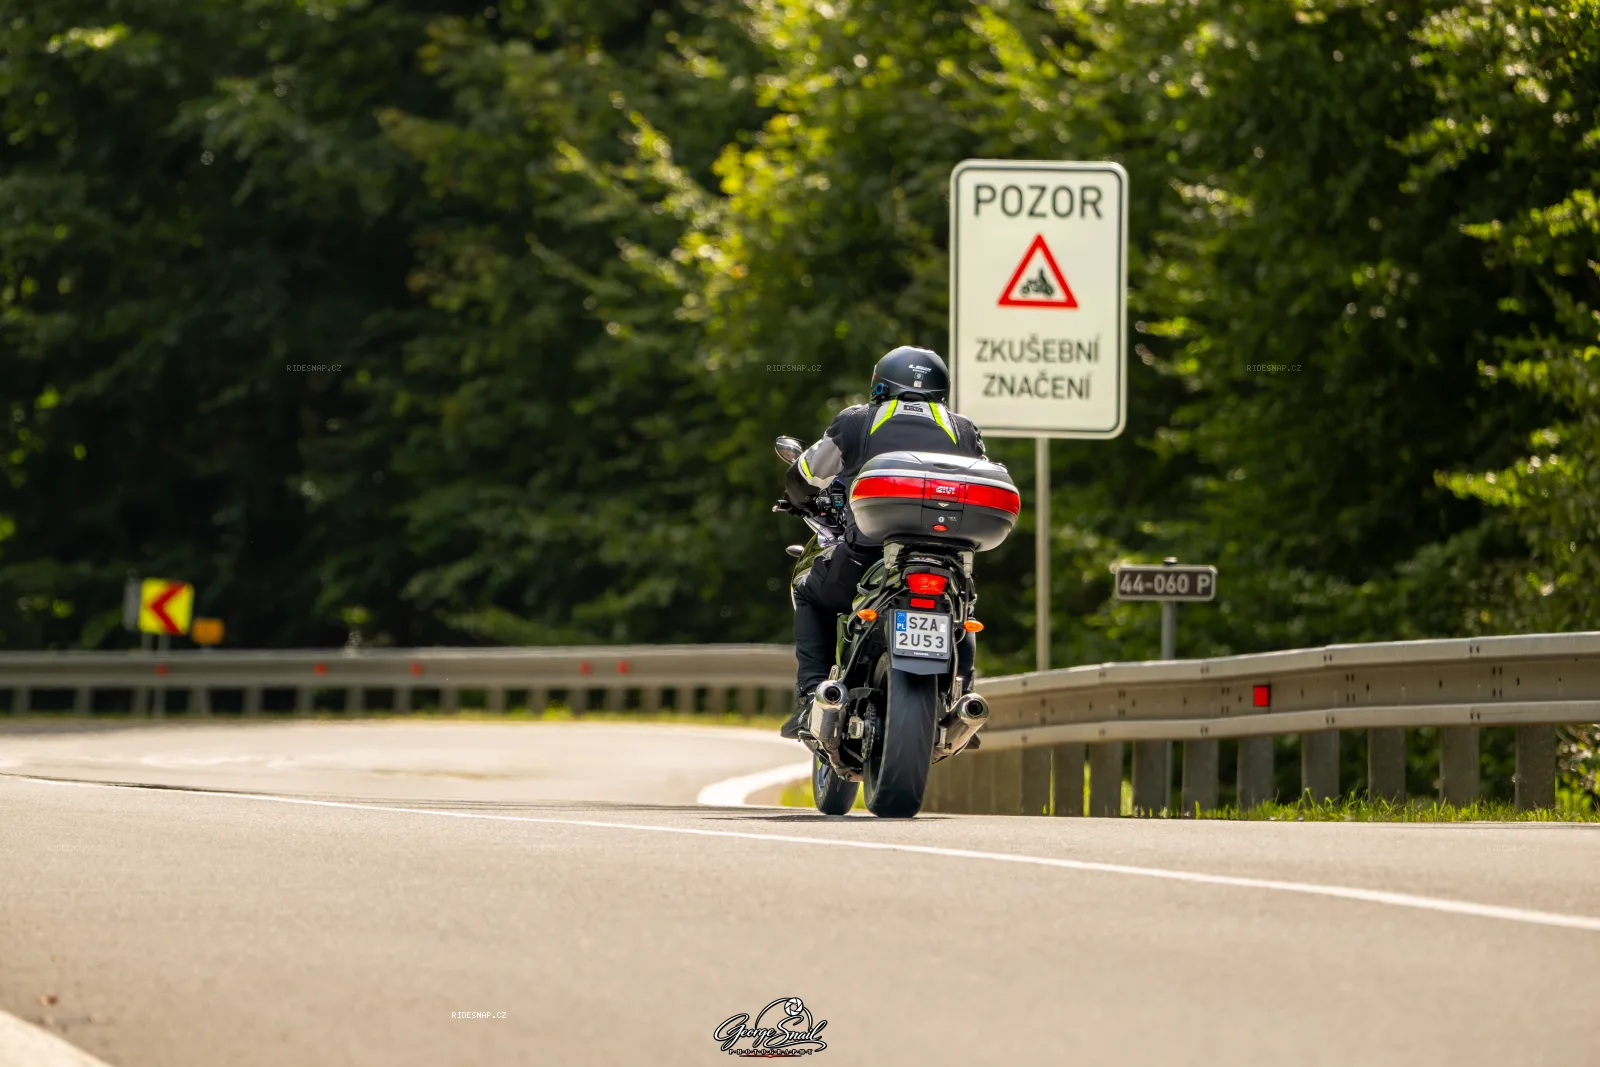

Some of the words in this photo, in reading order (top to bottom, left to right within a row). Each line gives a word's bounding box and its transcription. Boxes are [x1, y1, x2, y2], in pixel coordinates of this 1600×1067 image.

[973, 184, 1103, 219] POZOR
[975, 332, 1101, 364] ZKUŠEBNÍ
[982, 369, 1092, 400] ZNAČENÍ
[1120, 573, 1190, 594] 44-060
[1196, 573, 1211, 594] P
[909, 617, 938, 631] SZA
[899, 633, 944, 649] 2U53
